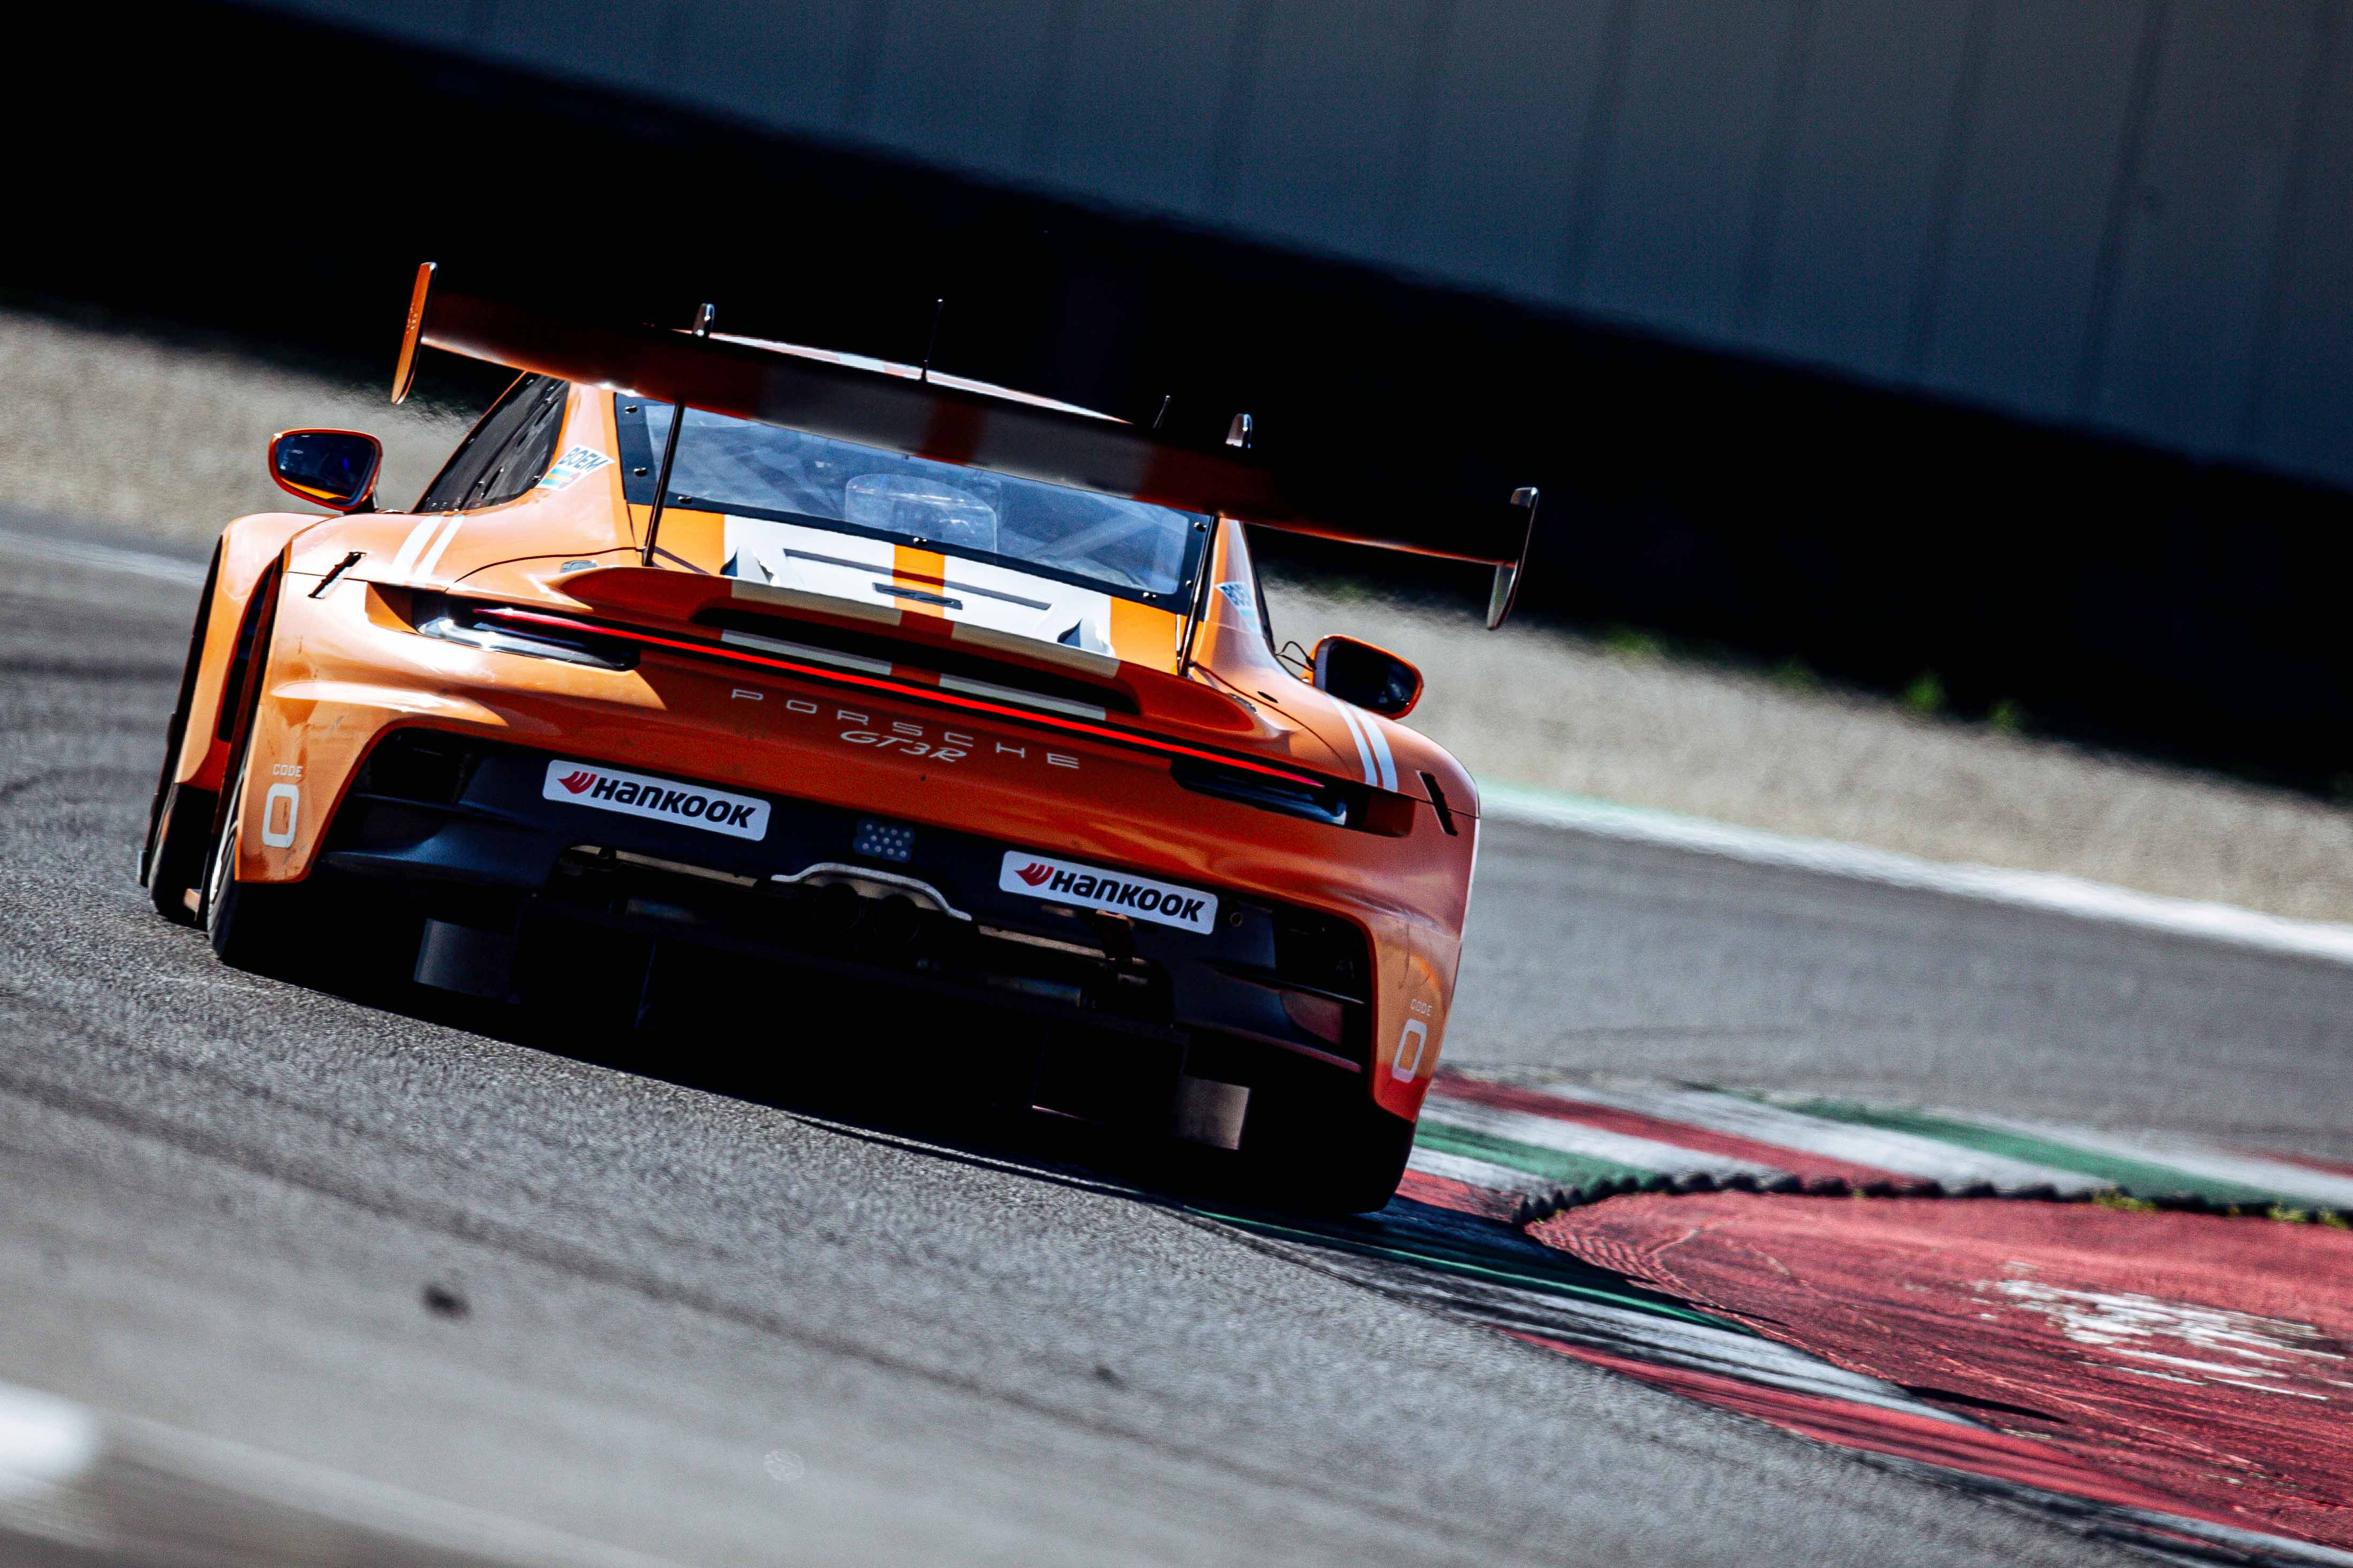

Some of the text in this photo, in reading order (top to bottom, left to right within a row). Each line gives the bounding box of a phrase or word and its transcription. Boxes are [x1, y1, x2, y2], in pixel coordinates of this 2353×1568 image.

[557, 446, 608, 472] BOEM
[731, 689, 1079, 769] PORSCHE
[840, 730, 967, 762] GT3R
[273, 763, 304, 778] CODE
[1410, 998, 1433, 1016] CODE
